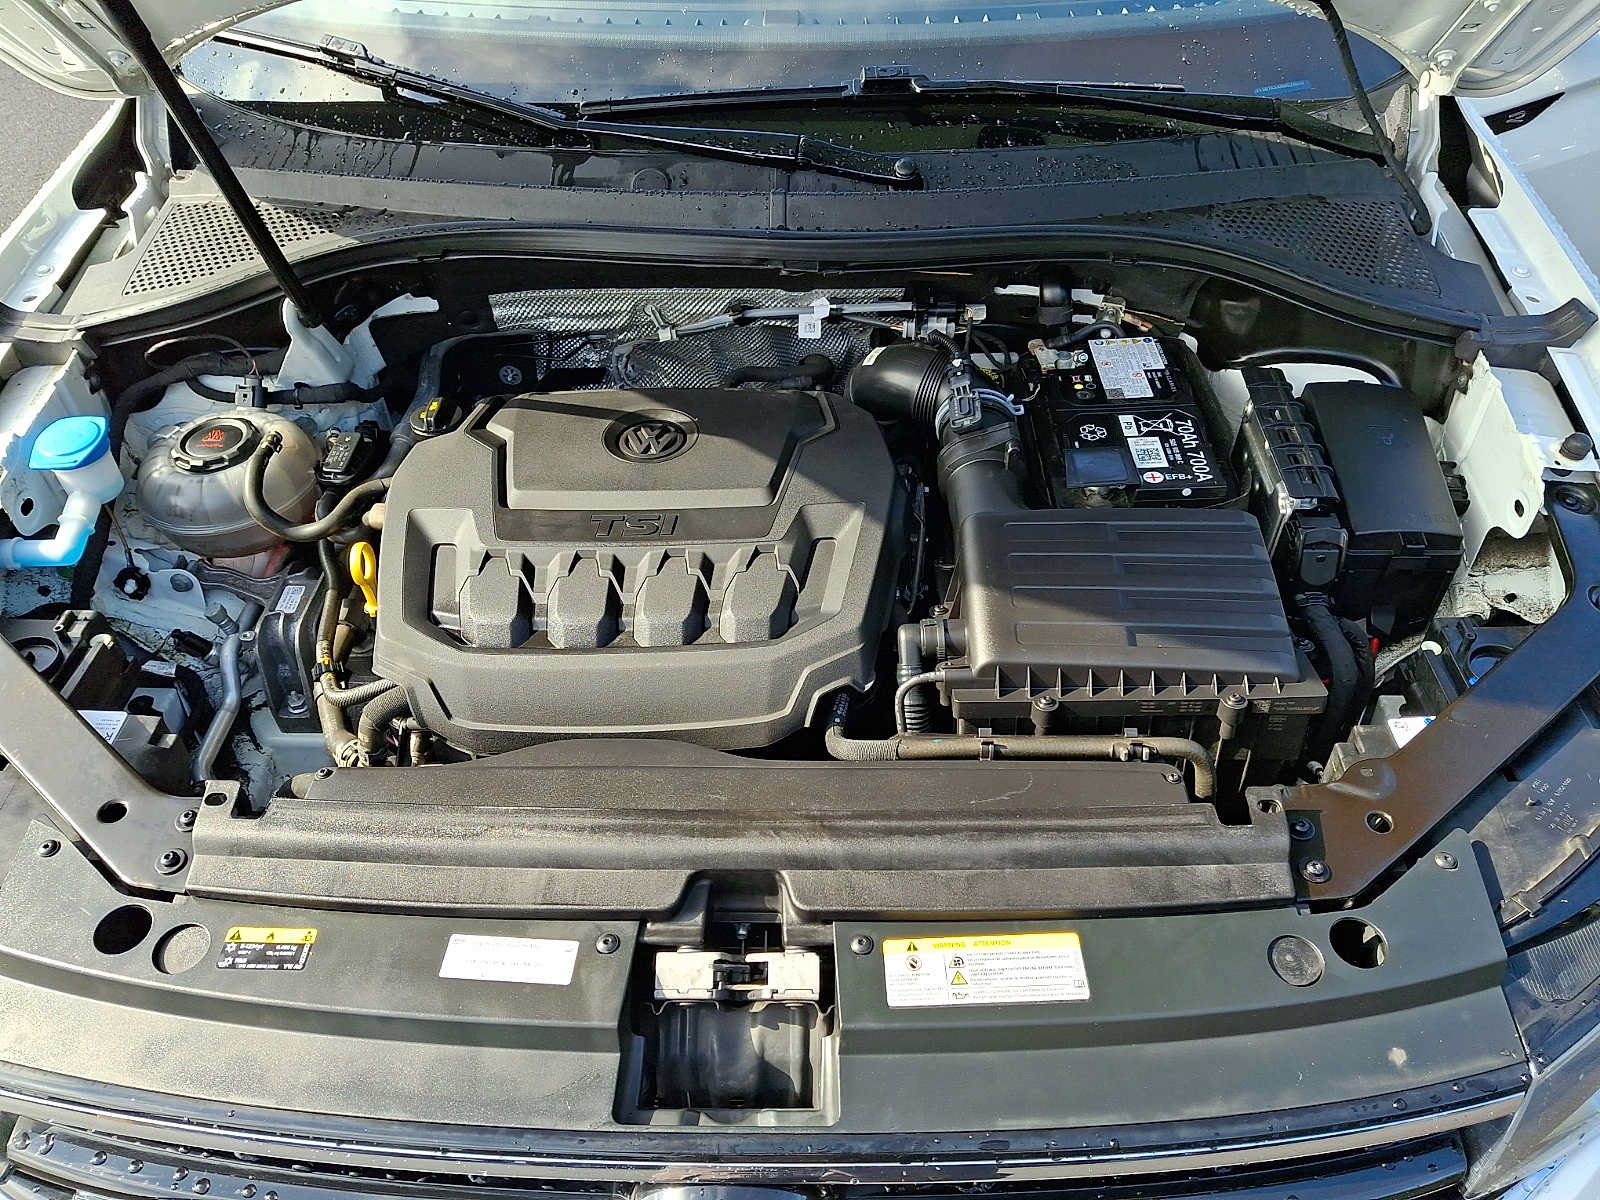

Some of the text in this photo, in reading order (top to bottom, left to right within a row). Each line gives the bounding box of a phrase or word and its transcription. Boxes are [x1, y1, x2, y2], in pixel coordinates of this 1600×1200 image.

[1123, 421, 1134, 431] Pb
[1174, 419, 1200, 449] 70Ah
[1186, 451, 1214, 483] 700A
[590, 513, 680, 538] TSI
[933, 941, 967, 949] WARNING
